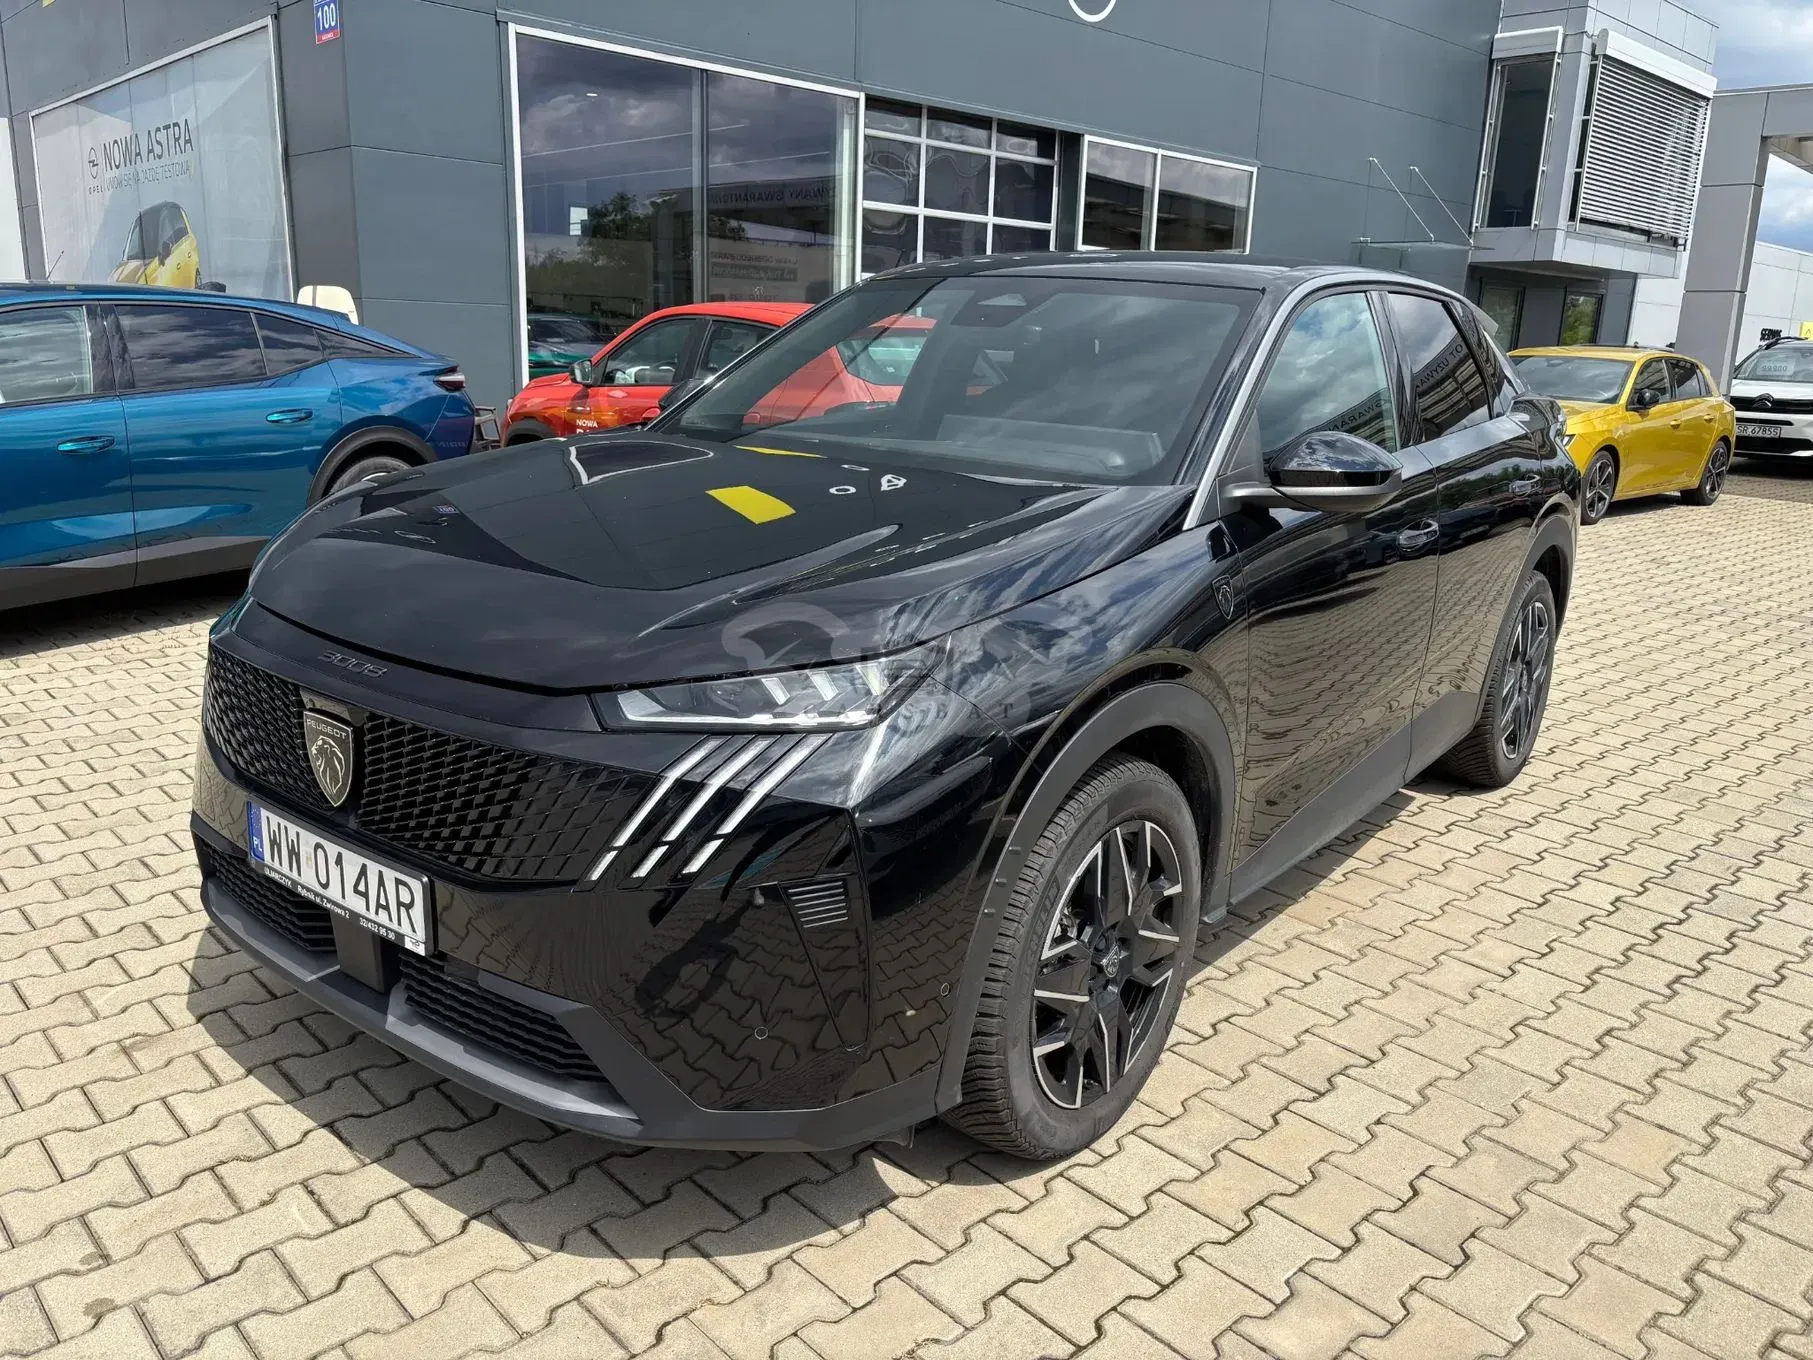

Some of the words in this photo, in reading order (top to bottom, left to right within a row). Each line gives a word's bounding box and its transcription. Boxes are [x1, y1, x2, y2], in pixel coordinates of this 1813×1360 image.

[317, 2, 337, 31] 100
[103, 133, 143, 172] NOWA
[146, 118, 194, 162] ASTRA
[576, 419, 599, 428] NOWA
[318, 649, 388, 678] 3008
[306, 718, 347, 740] PEUGEOT
[252, 835, 263, 852] PL
[266, 815, 302, 880] WW
[313, 841, 418, 935] 014AR
